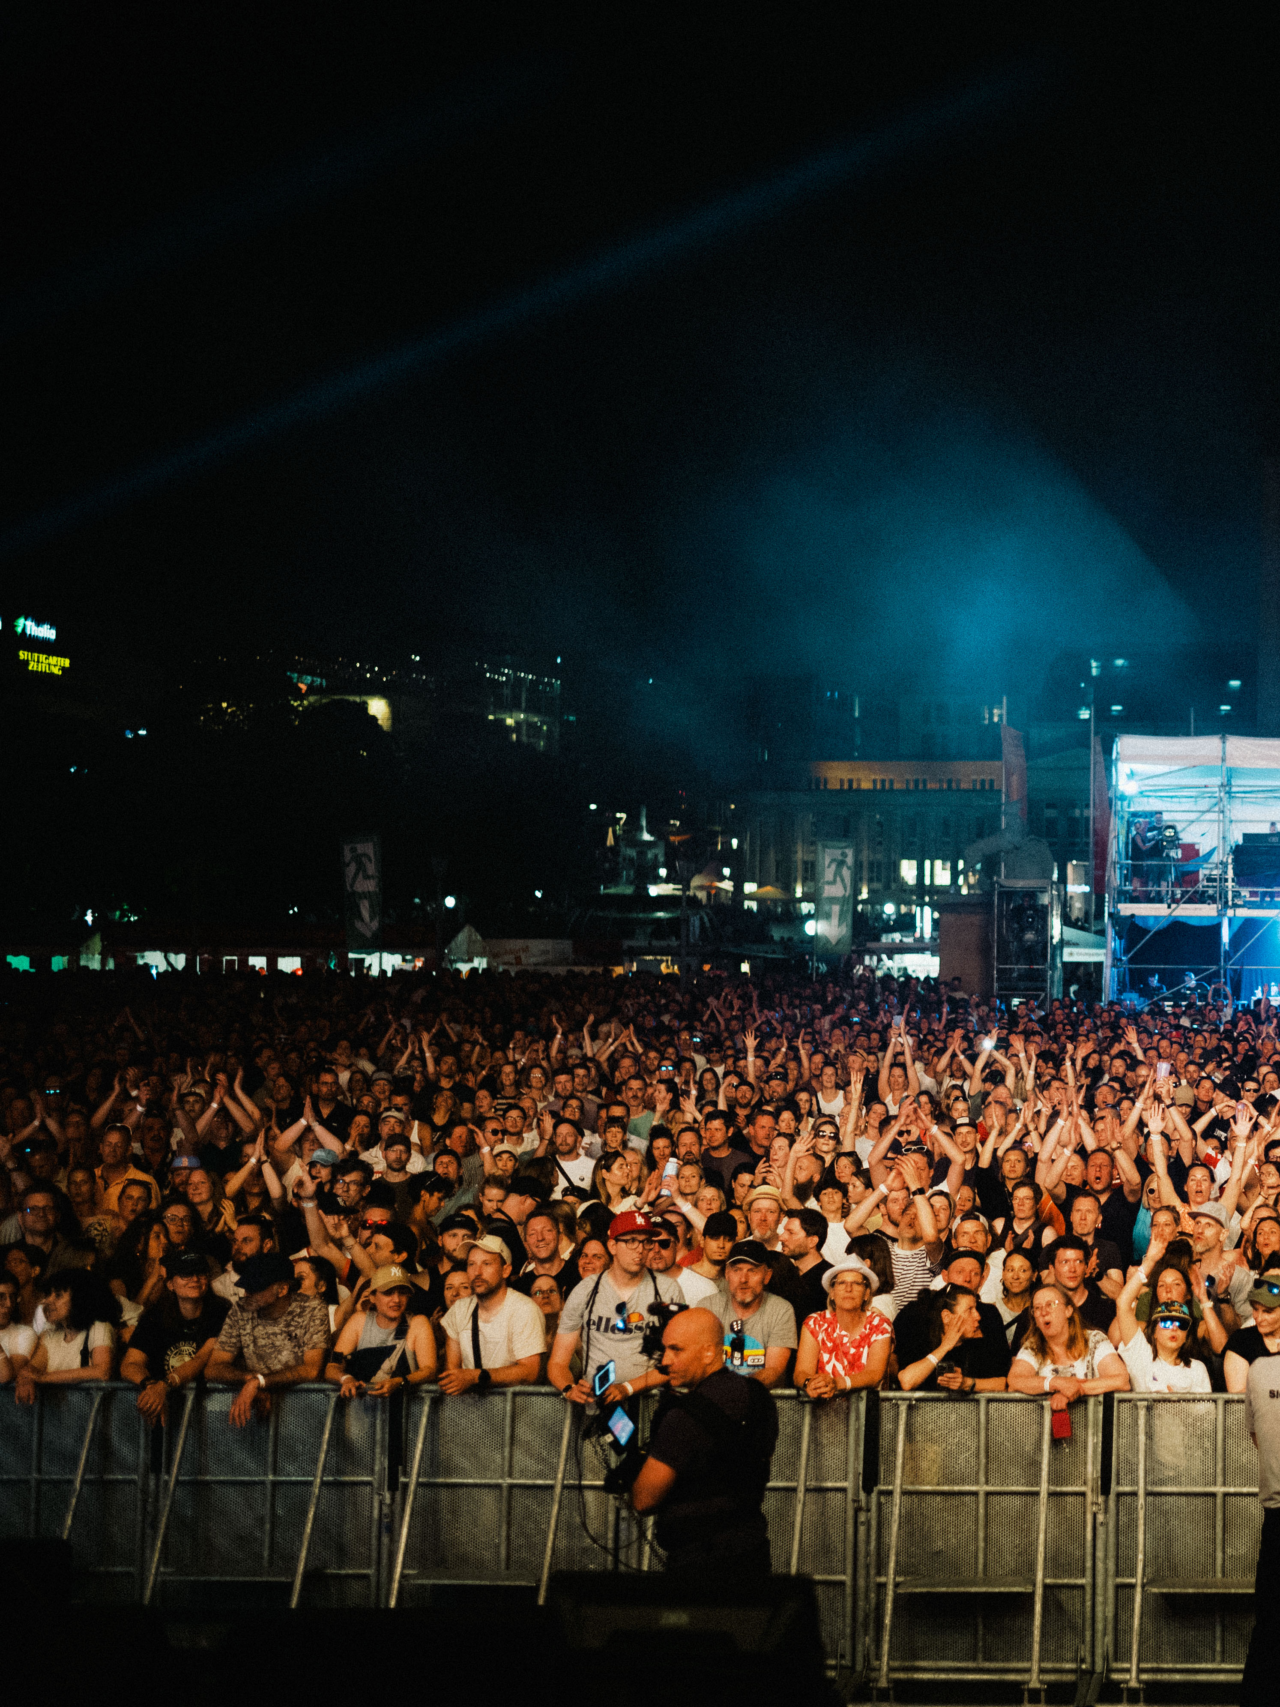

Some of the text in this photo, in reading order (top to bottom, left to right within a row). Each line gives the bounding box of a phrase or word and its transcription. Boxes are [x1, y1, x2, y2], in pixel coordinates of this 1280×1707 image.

[25, 619, 57, 640] Thalia
[18, 650, 70, 668] STUTTGARTER
[28, 661, 62, 676] ZEITUNG
[634, 1212, 646, 1225] LA
[390, 1266, 402, 1277] NY
